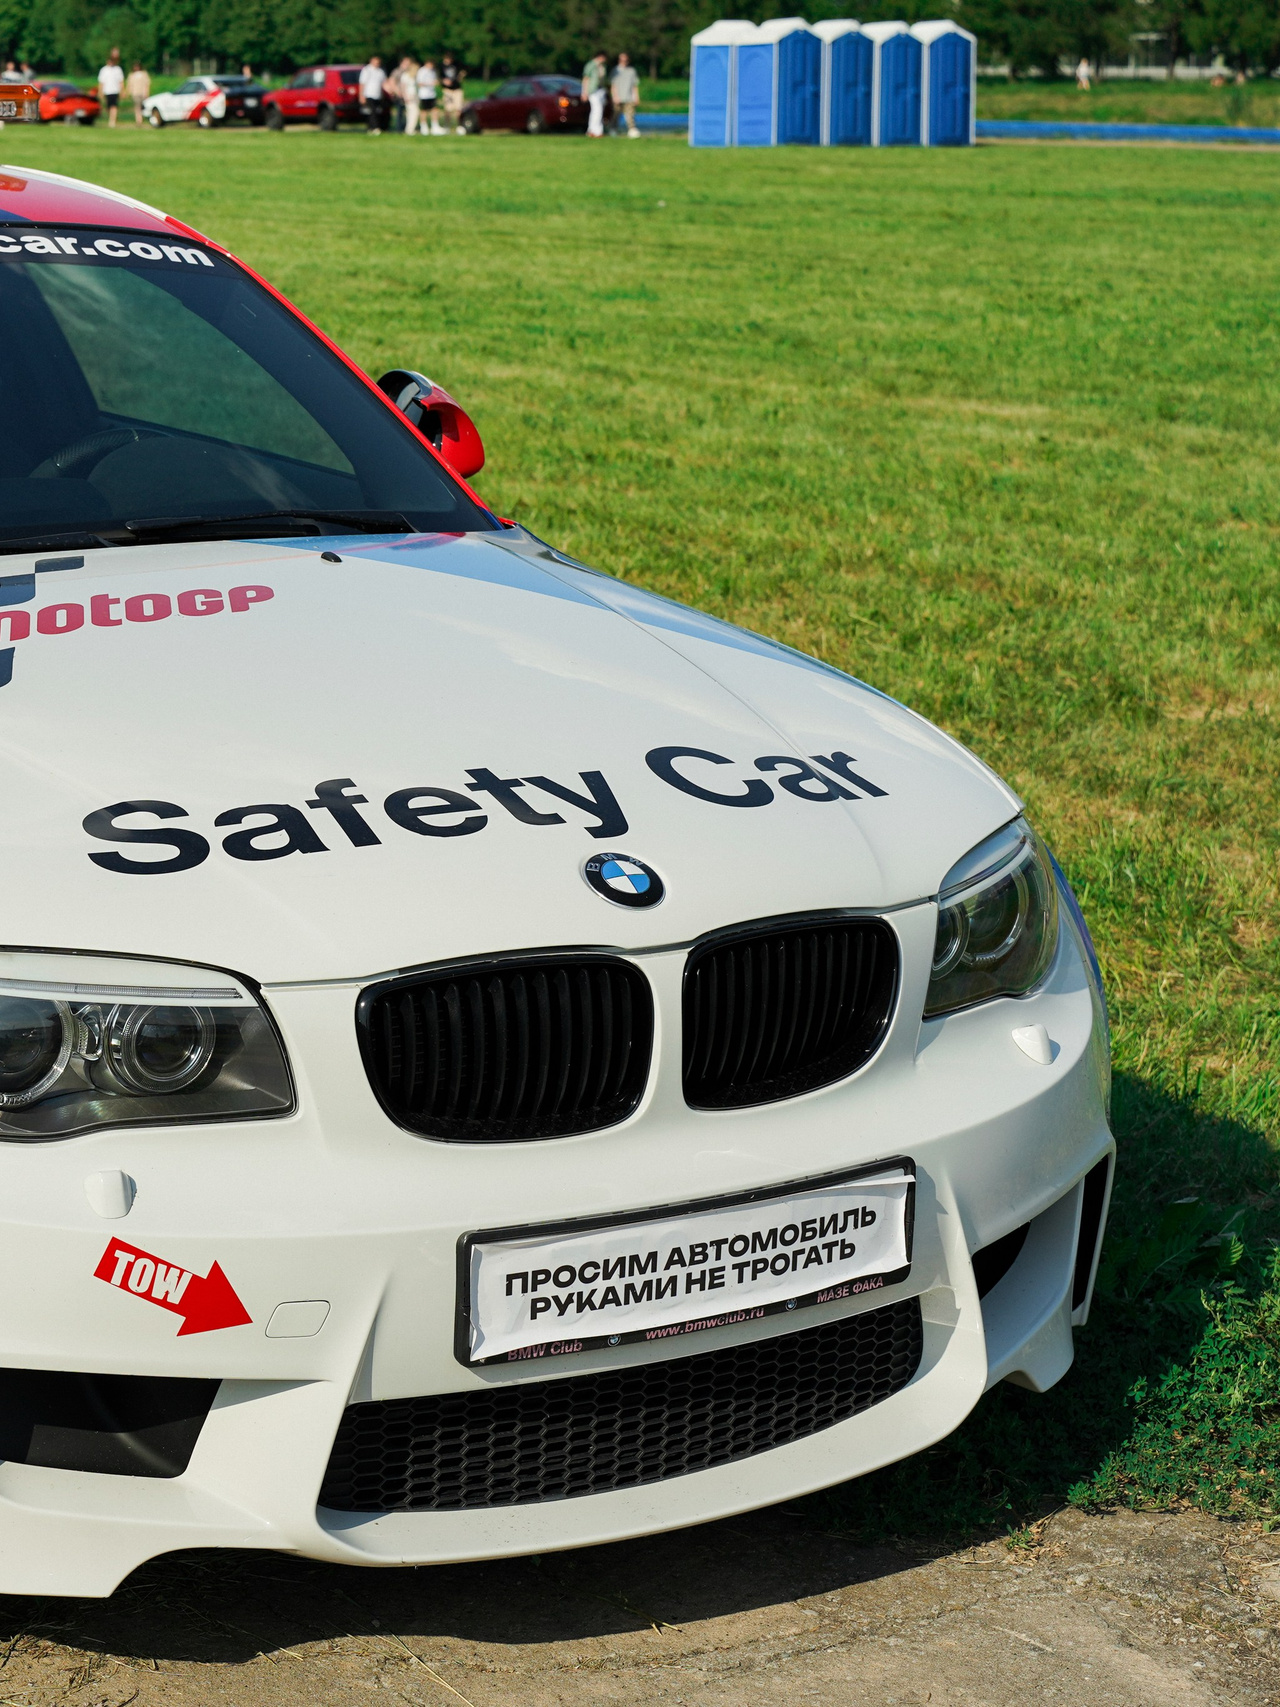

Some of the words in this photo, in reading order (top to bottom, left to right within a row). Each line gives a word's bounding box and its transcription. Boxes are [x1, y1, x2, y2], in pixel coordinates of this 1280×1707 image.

[81, 766, 629, 875] Safety
[644, 745, 892, 809] Car
[586, 853, 644, 873] BMW
[505, 1250, 658, 1297] ПРОСИМ
[664, 1205, 877, 1271] АВТОМОБИЛЬ
[110, 1249, 193, 1305] TOW
[530, 1275, 677, 1320] РУКАМИ
[684, 1266, 726, 1294] НЕ
[731, 1237, 856, 1285] ТРОГАТЬ
[816, 1284, 850, 1304] МАЗЕ
[852, 1275, 884, 1294] ФАКА
[645, 1307, 764, 1340] www.bmwclub.ru
[507, 1343, 546, 1361] BMW
[550, 1339, 583, 1355] Club
